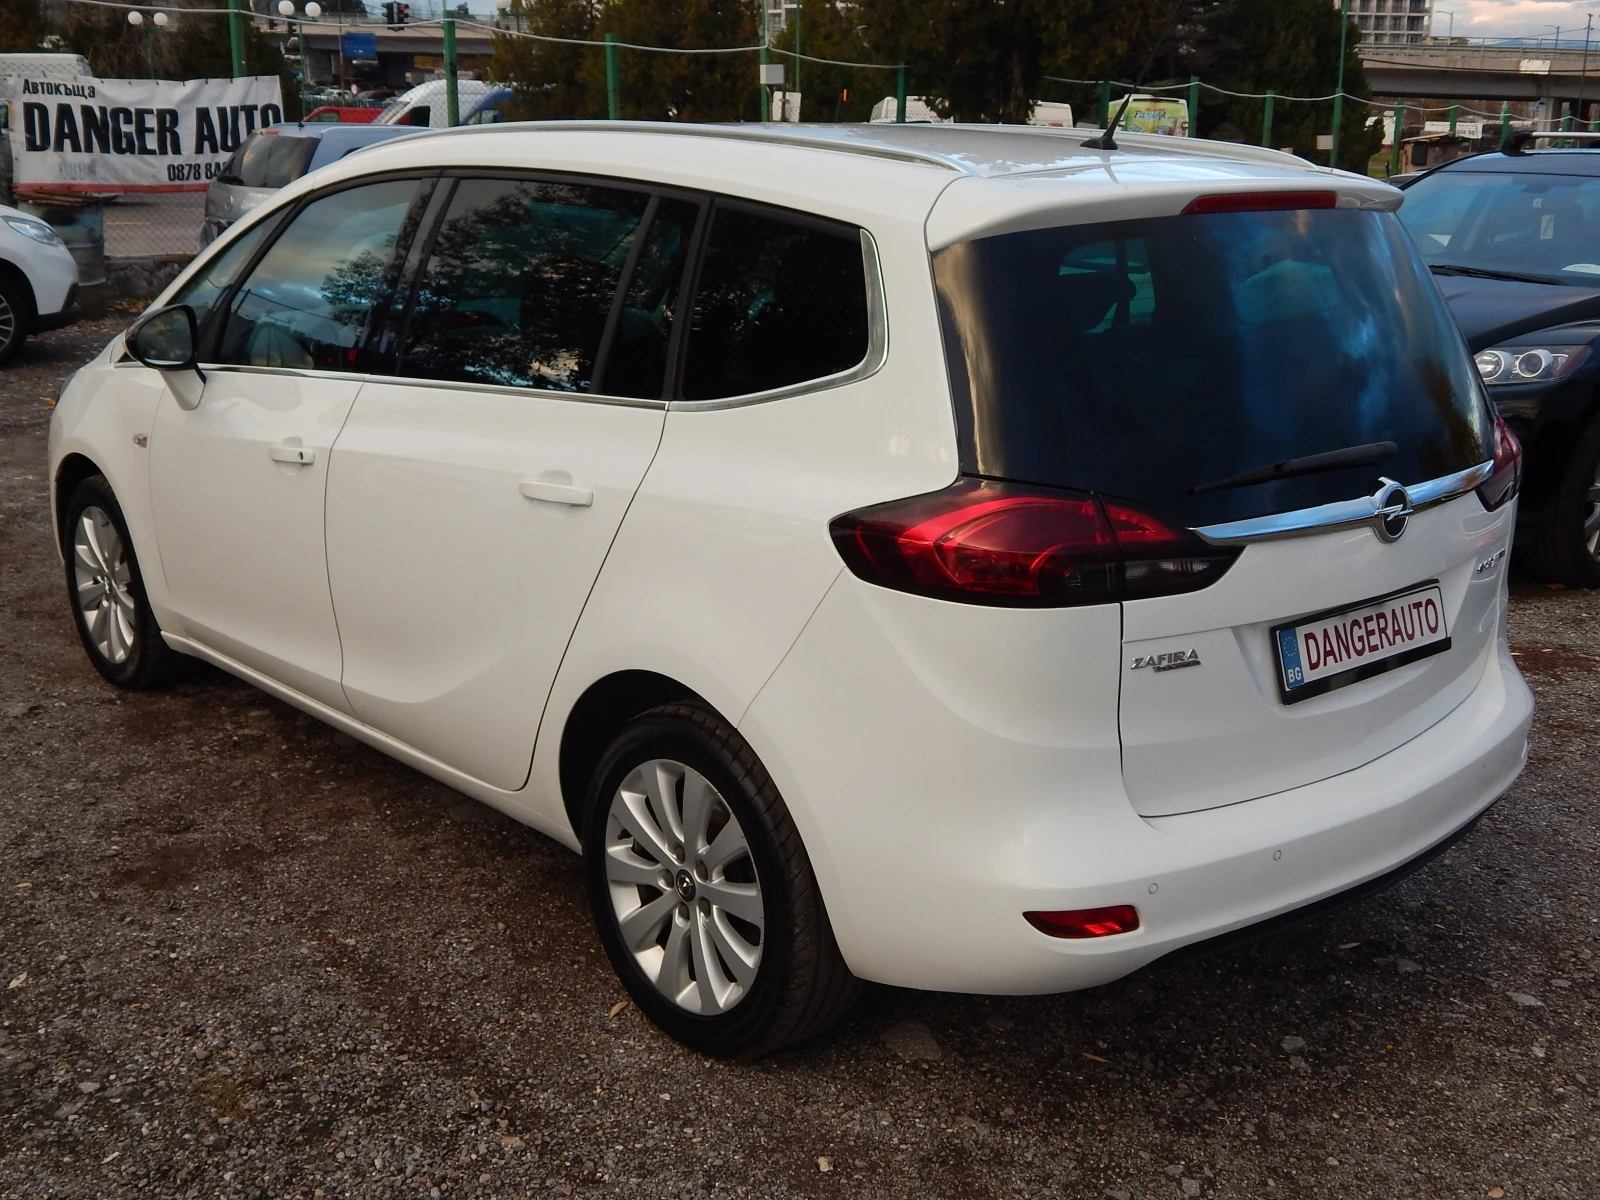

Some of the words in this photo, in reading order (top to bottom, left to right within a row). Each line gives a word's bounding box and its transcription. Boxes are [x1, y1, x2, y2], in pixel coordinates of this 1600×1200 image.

[22, 78, 96, 100] Автокъща
[23, 101, 182, 155] DANGER
[167, 163, 201, 181] 0878
[204, 162, 228, 180] 84
[1304, 598, 1439, 671] DANGERAUTO
[1131, 648, 1199, 670] ZAFIRA
[1287, 667, 1302, 683] BG
